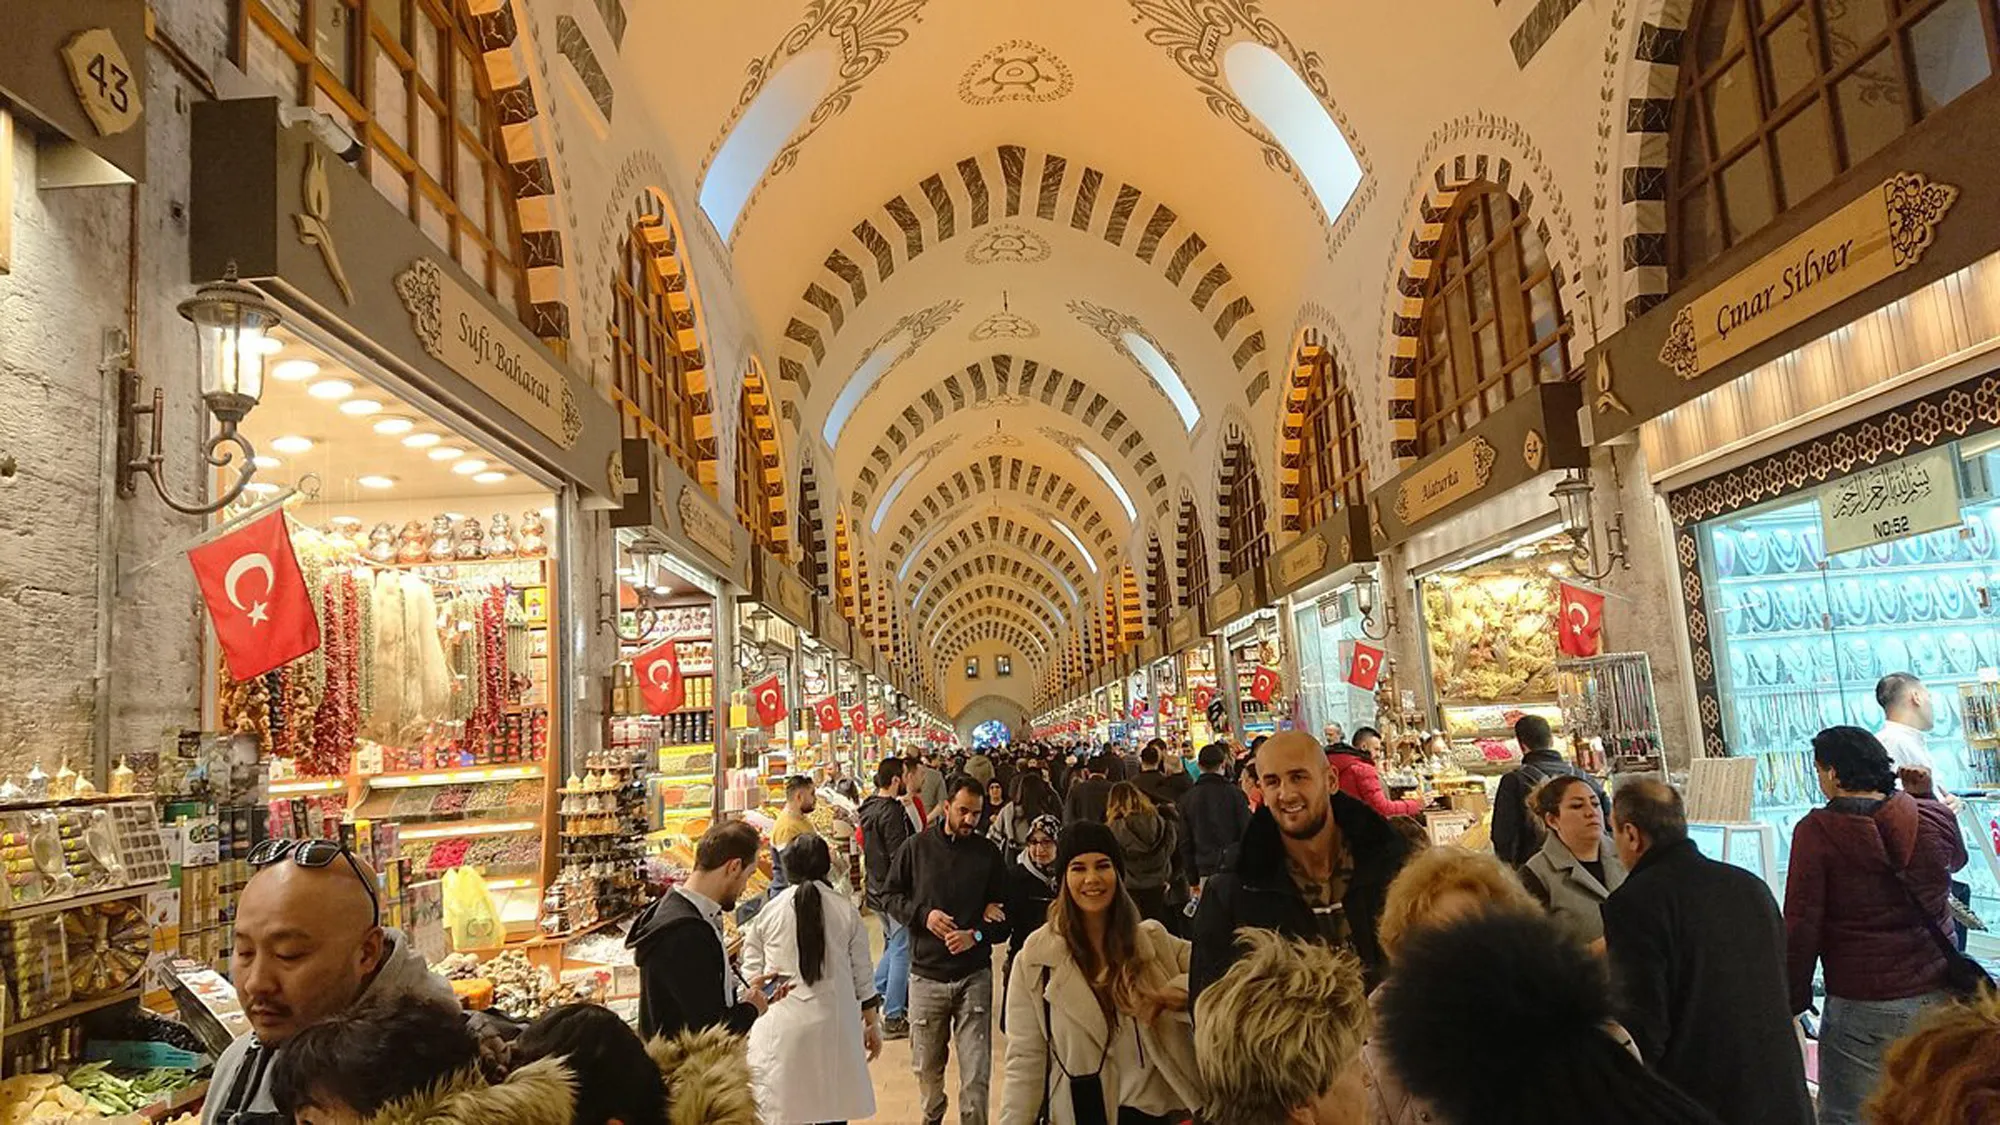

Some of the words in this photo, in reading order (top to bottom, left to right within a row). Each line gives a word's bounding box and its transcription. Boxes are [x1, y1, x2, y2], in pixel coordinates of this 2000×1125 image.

[86, 53, 129, 113] 43
[1782, 239, 1854, 300] Silver
[458, 312, 491, 365] Sufi
[494, 341, 550, 408] Baharat
